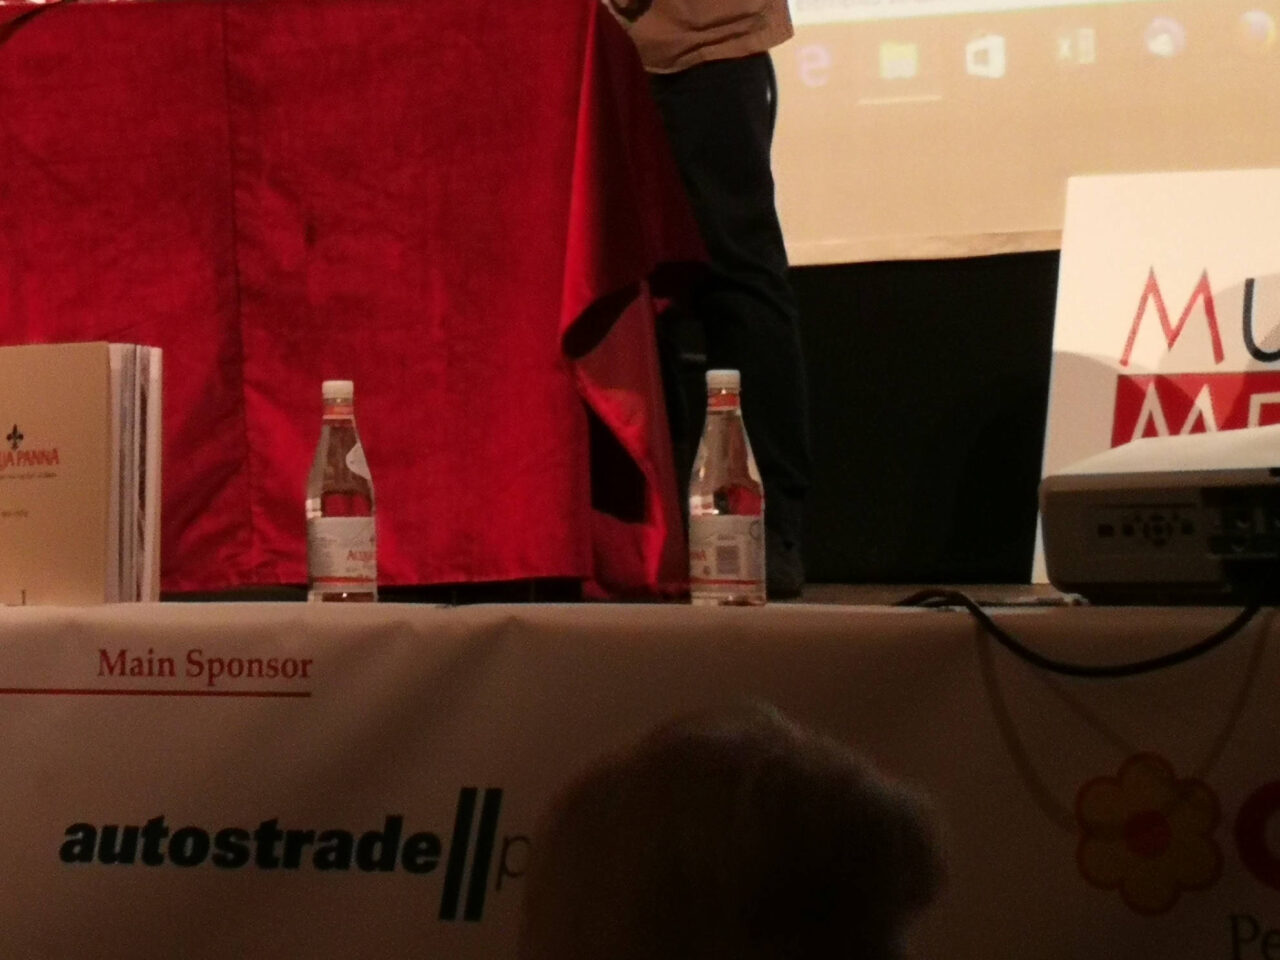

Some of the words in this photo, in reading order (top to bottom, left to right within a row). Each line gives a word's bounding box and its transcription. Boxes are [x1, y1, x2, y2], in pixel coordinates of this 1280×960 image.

[17, 448, 60, 466] PANNA
[97, 648, 176, 678] Main
[185, 648, 313, 687] Sponsor
[59, 814, 441, 873] autostrade
